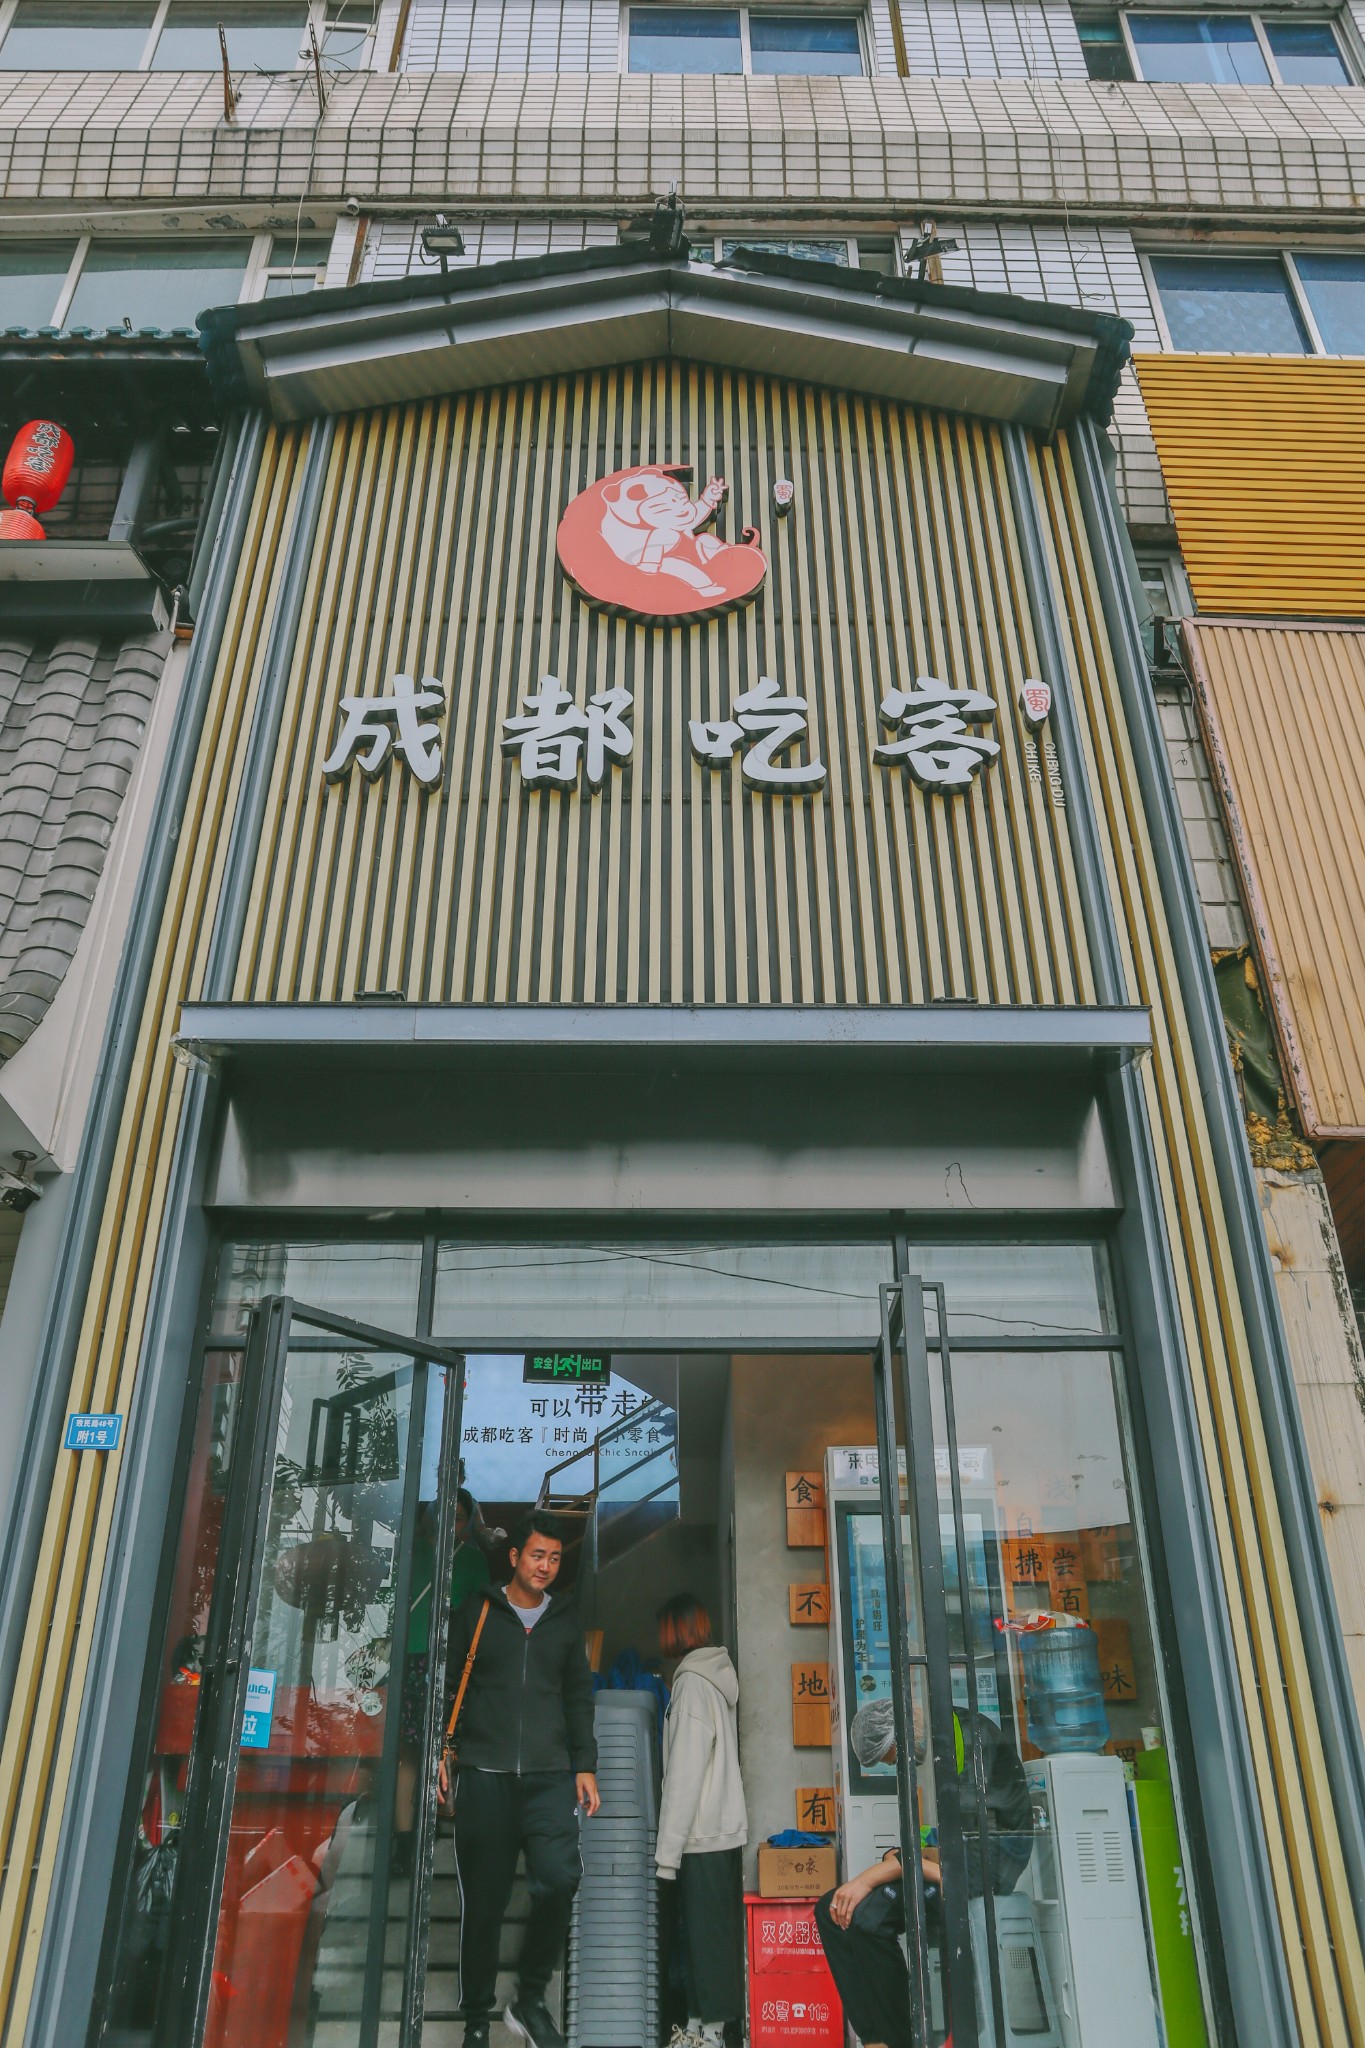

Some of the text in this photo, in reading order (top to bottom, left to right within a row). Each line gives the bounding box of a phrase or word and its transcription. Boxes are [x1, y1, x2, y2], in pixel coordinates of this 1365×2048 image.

[323, 673, 1000, 786] 成都吃客
[1025, 742, 1042, 783] CHIKE
[1044, 742, 1066, 808] CHENG DU
[533, 1356, 602, 1371] 安全 出口
[76, 1430, 107, 1444] 附1号
[790, 1475, 820, 1503] 食
[1051, 1547, 1078, 1577] 尝
[796, 1590, 823, 1616] 不
[1058, 1587, 1083, 1613] 百
[797, 1671, 827, 1698] 地
[1101, 1664, 1132, 1694] 味
[802, 1792, 832, 1825] 有
[761, 2000, 829, 2022] 火警 119
